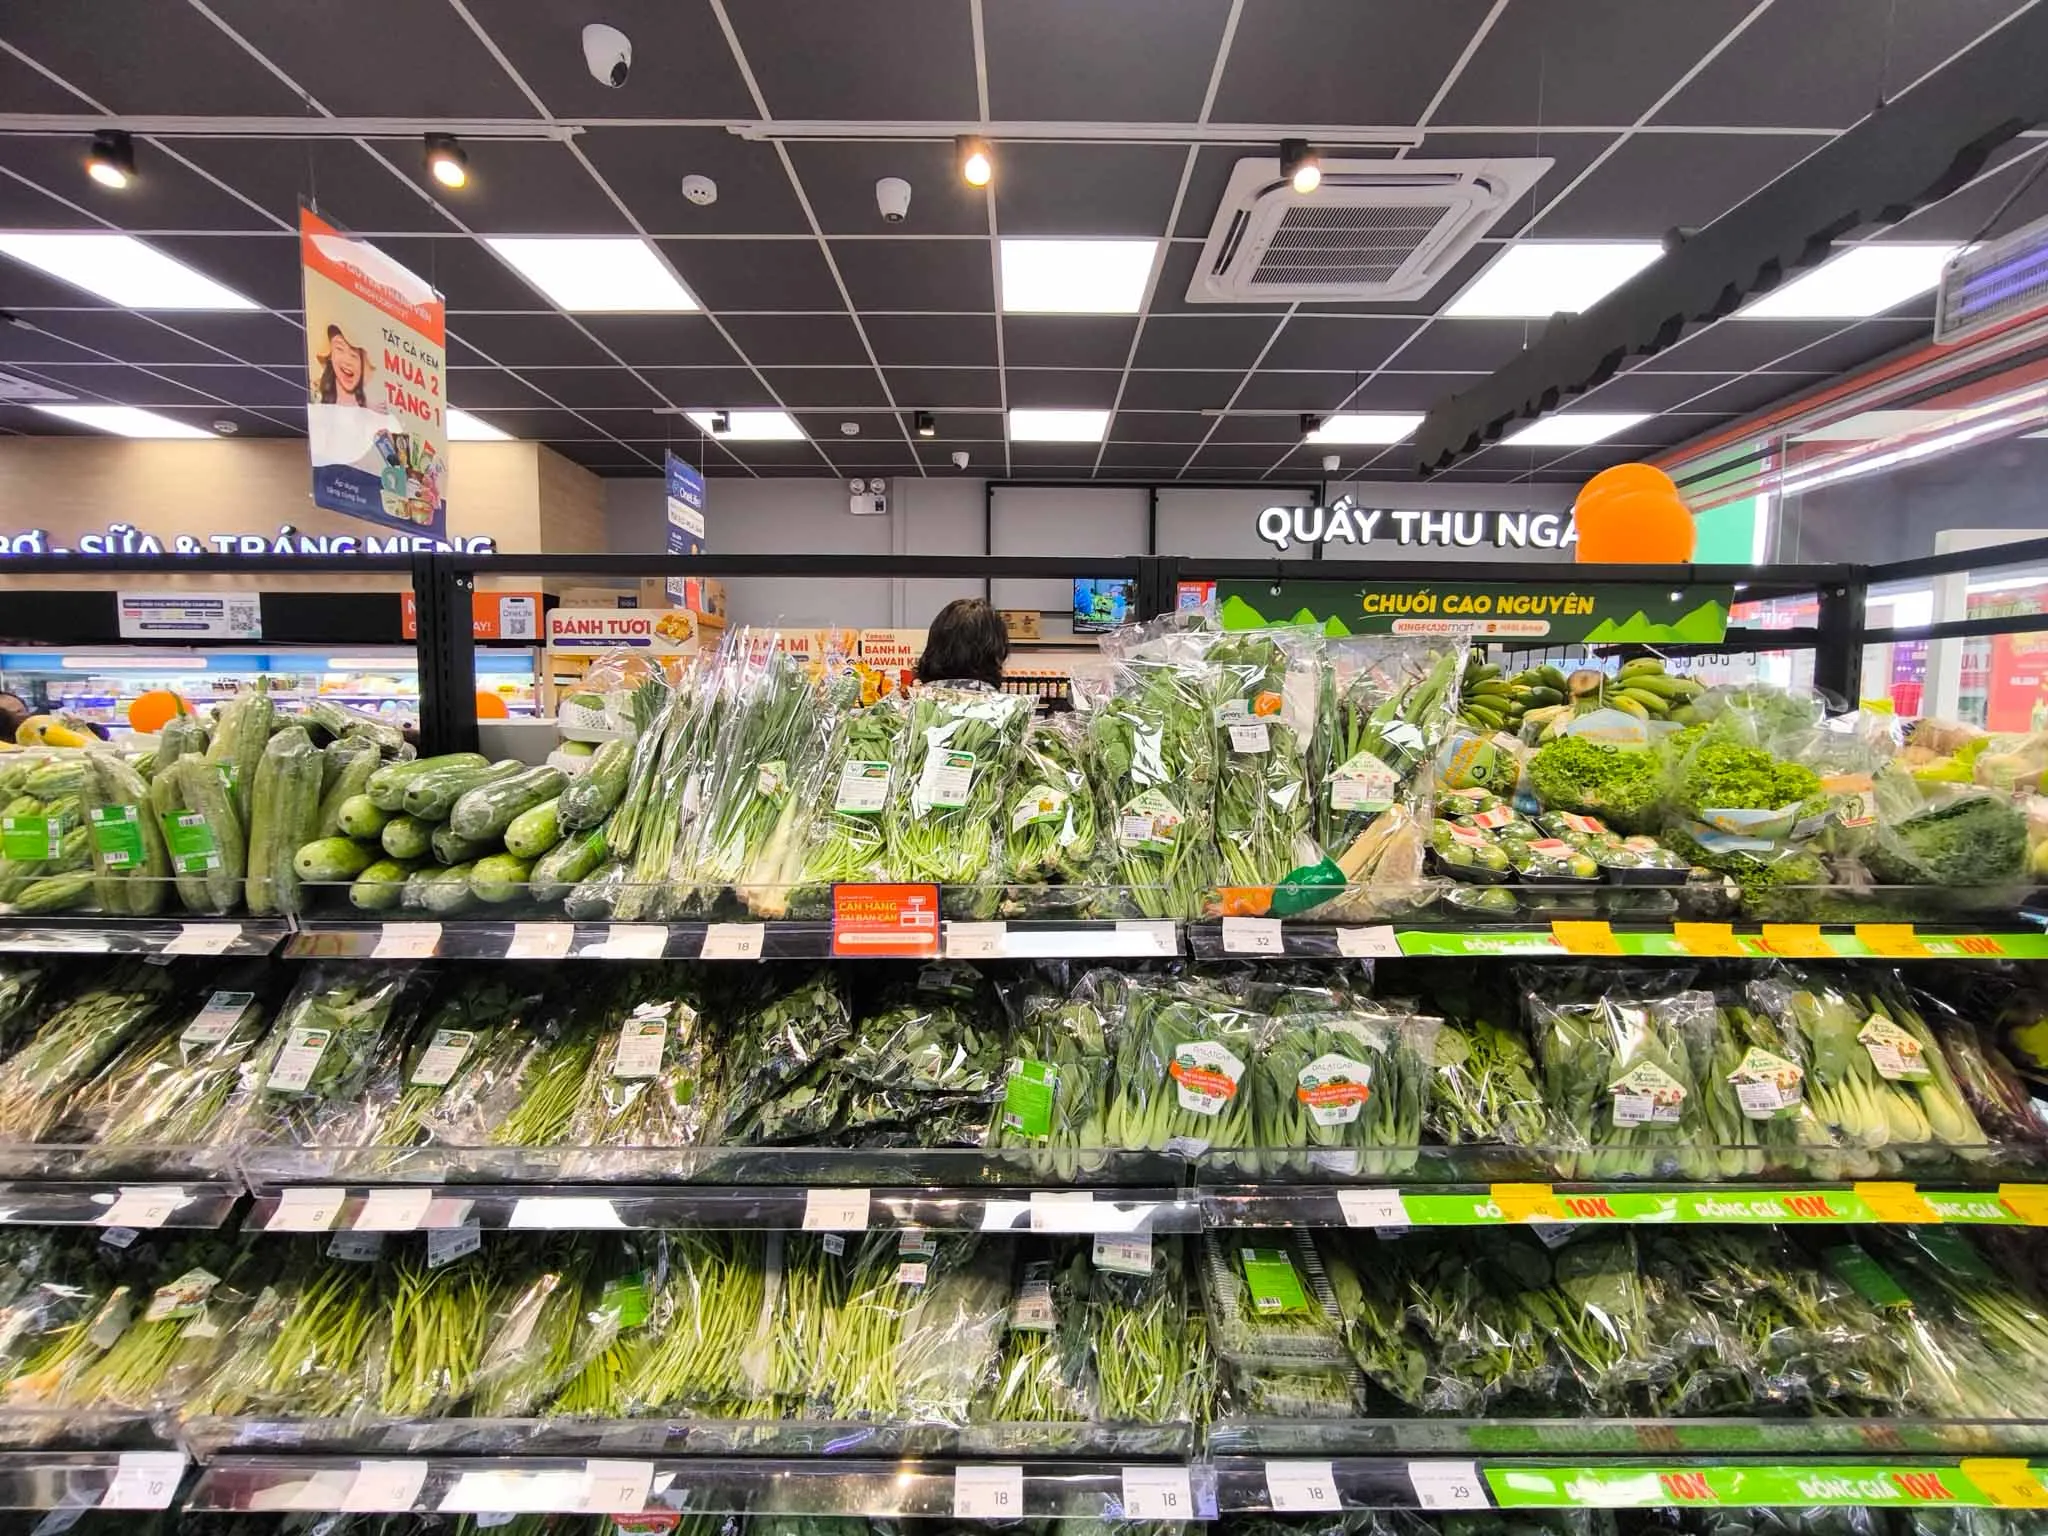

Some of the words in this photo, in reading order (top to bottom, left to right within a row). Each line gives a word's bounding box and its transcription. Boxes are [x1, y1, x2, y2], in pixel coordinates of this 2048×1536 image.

[384, 348, 426, 391] MUA
[431, 374, 439, 396] 2
[1258, 495, 1381, 549] QUẦY
[1391, 511, 1484, 546] THU
[1363, 588, 1436, 613] CHUỐI
[1443, 595, 1492, 614] CAO
[1496, 592, 1595, 615] NGUYÊN
[552, 616, 603, 634] BÁNH
[607, 618, 650, 634] TƯƠI
[737, 942, 749, 951] 18
[982, 941, 993, 951] 21
[1257, 937, 1270, 946] 32
[1378, 1208, 1392, 1217] 17
[1565, 1198, 1616, 1217] 10K
[1782, 1196, 1838, 1217] 10K
[841, 1211, 855, 1222] 17
[147, 1481, 163, 1497] 10
[619, 1485, 634, 1500] 17
[1306, 1487, 1323, 1500] 18
[1451, 1486, 1470, 1499] 29
[1658, 1472, 1718, 1500] 10K
[1891, 1472, 1956, 1500] 10K
[2013, 1485, 2032, 1498] 10
[993, 1491, 1008, 1505] 18
[1161, 1492, 1177, 1507] 18
